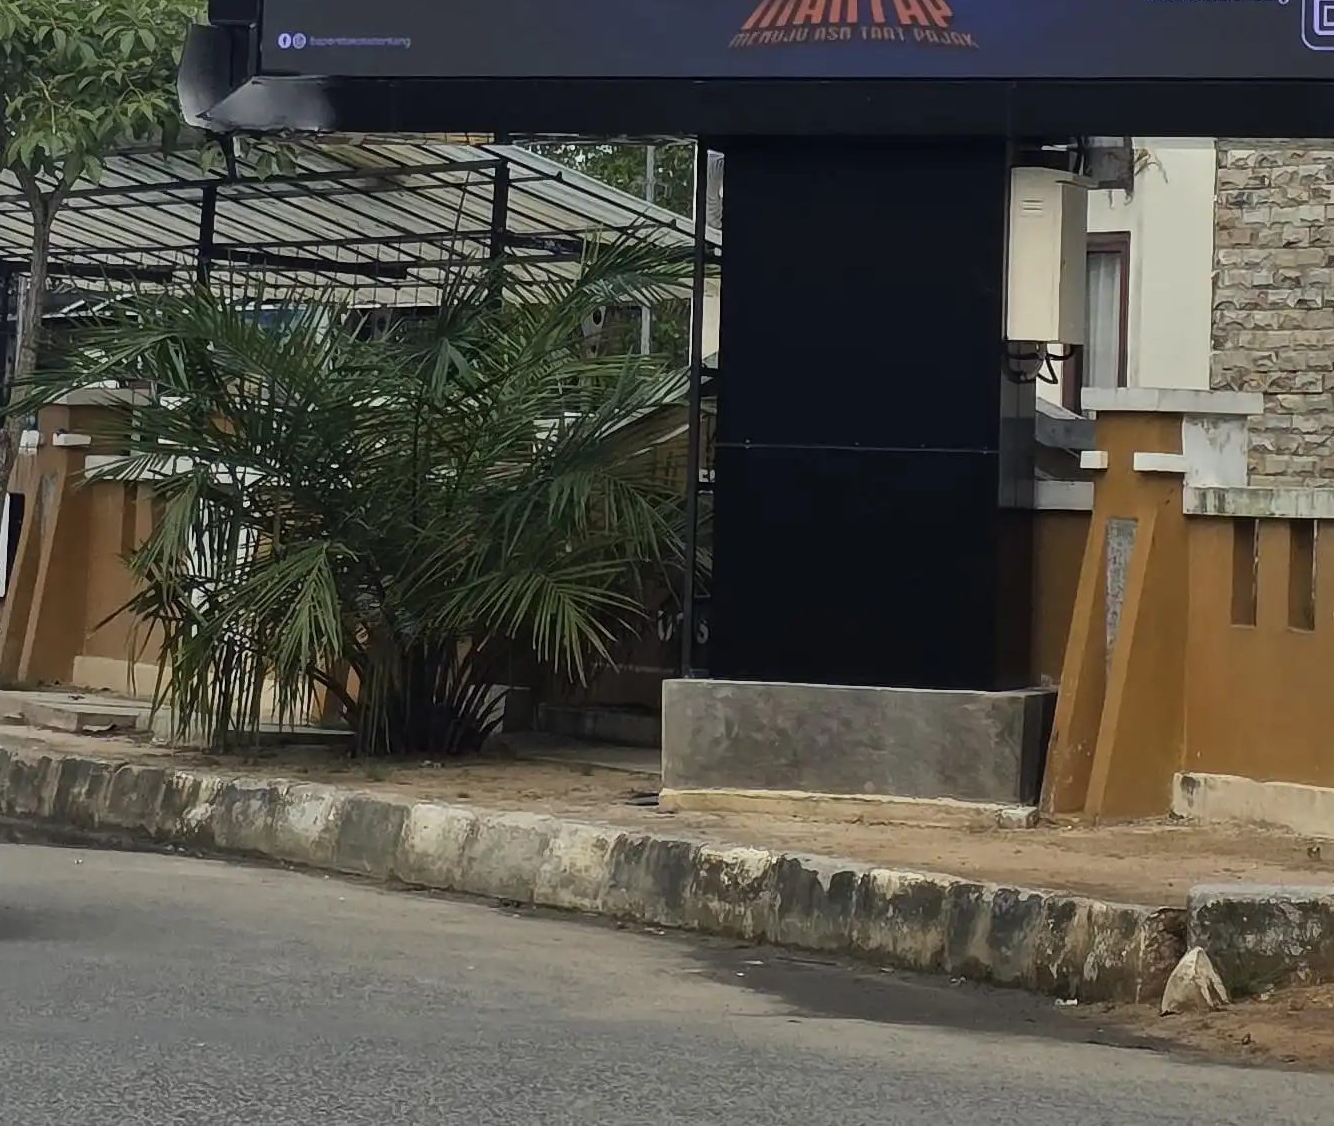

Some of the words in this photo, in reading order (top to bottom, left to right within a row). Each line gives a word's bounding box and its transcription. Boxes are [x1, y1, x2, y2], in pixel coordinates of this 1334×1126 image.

[814, 26, 852, 41] ASN
[861, 26, 905, 42] TAAT
[913, 28, 980, 50] PAJAK
